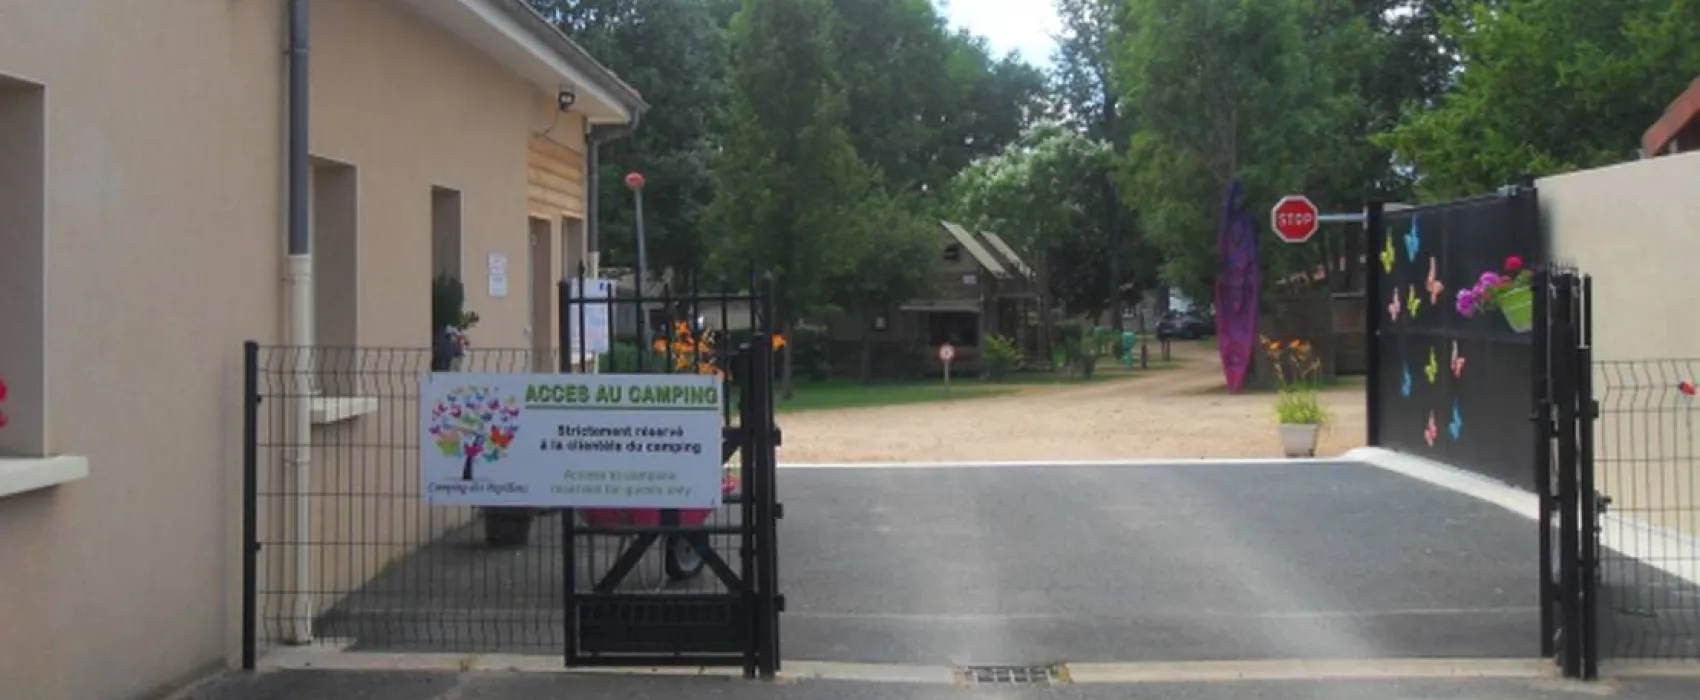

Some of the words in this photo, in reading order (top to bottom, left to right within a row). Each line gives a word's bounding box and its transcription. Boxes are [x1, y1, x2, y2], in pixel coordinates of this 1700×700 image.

[1278, 212, 1312, 227] STOP
[595, 384, 622, 403] AU
[628, 384, 719, 404] CAMPING
[558, 424, 632, 437] Strictement
[636, 424, 685, 437] réservé
[539, 438, 548, 450] à
[551, 439, 563, 450] la
[567, 439, 623, 450] clientèle
[626, 439, 643, 451] du
[646, 440, 703, 454] camping
